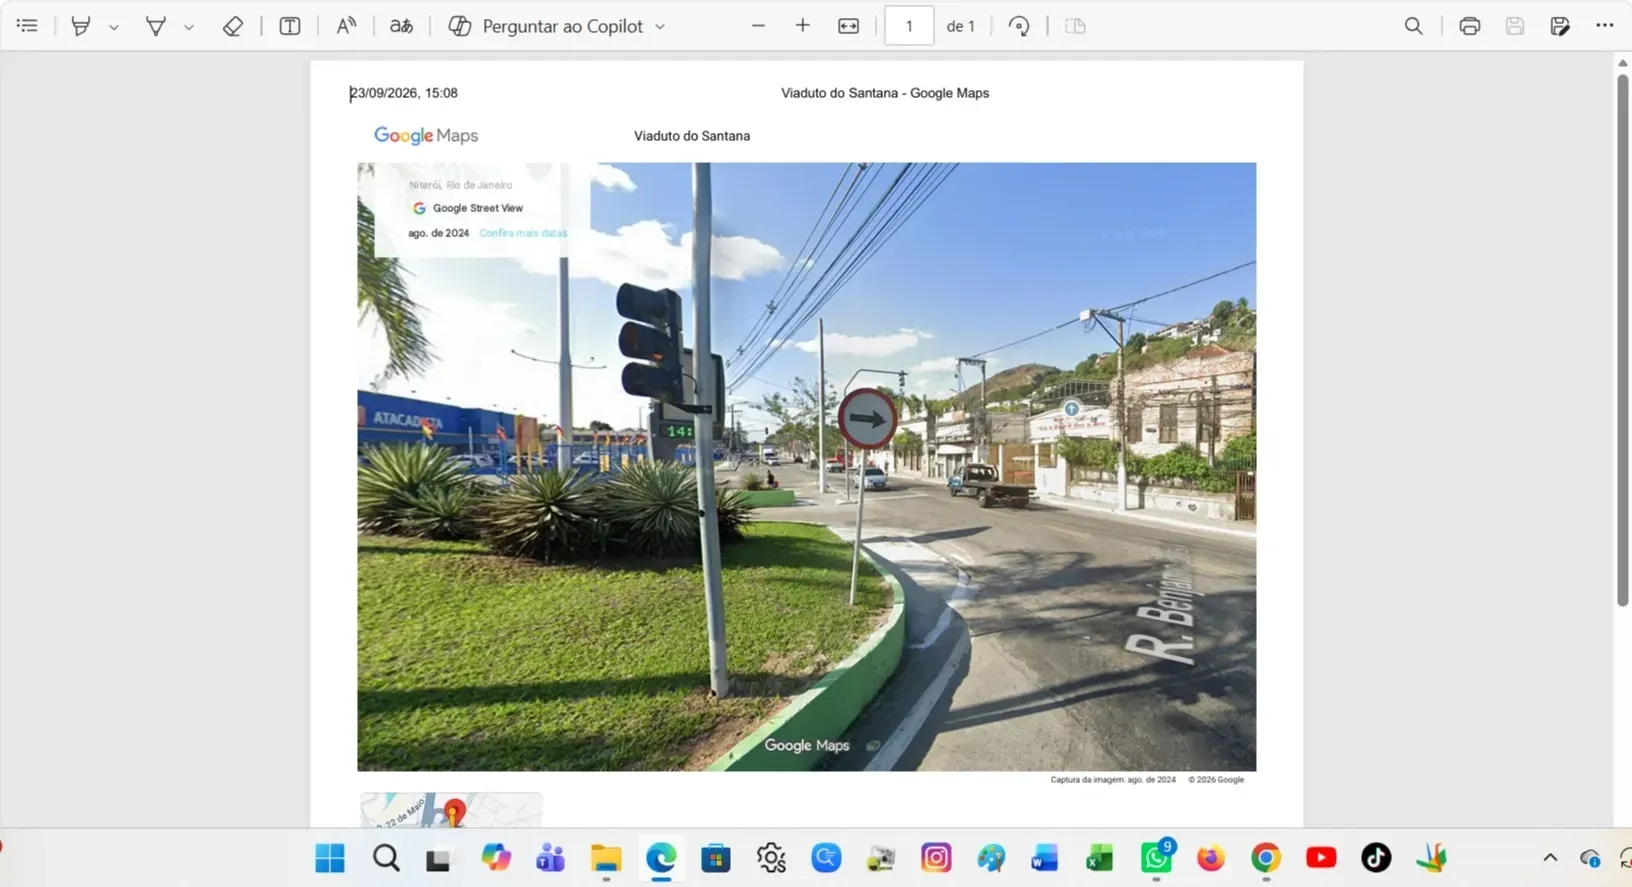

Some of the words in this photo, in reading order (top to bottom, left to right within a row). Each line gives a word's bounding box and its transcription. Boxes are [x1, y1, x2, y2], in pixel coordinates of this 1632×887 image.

[483, 18, 559, 38] Perguntar
[563, 22, 583, 34] ao
[587, 18, 644, 38] Copilot
[906, 20, 912, 33] 1
[946, 20, 964, 33] de
[968, 20, 975, 33] 1
[351, 87, 421, 100] 23/09/2026,
[425, 87, 459, 99] 15:08
[780, 87, 827, 99] Viaduto
[829, 87, 846, 99] do
[848, 87, 899, 99] Santana
[909, 87, 954, 102] Google
[956, 87, 990, 101] Maps
[374, 126, 434, 147] Google
[436, 128, 479, 146] Maps
[634, 130, 681, 142] Viaduto
[683, 130, 699, 142] do
[701, 130, 751, 142] Santana
[446, 180, 461, 190] Rio
[463, 180, 476, 190] de
[478, 180, 513, 190] Janeiro
[432, 203, 468, 215] Google
[470, 203, 500, 213] Street
[501, 203, 524, 213] View
[408, 229, 429, 240] ago.
[431, 228, 444, 238] de
[445, 228, 470, 238] 2024
[479, 228, 515, 238] Confira
[516, 228, 539, 238] mais
[541, 228, 568, 238] datas
[373, 411, 444, 429] ATACADTA
[1050, 775, 1081, 786] Captura
[1081, 775, 1093, 784] da
[1127, 777, 1144, 786] ago.
[1145, 775, 1156, 784] de
[1156, 775, 1177, 784] 2024
[1196, 775, 1217, 784] 2026
[1217, 775, 1245, 786] Google
[397, 813, 407, 823] de
[406, 798, 425, 816] Maio
